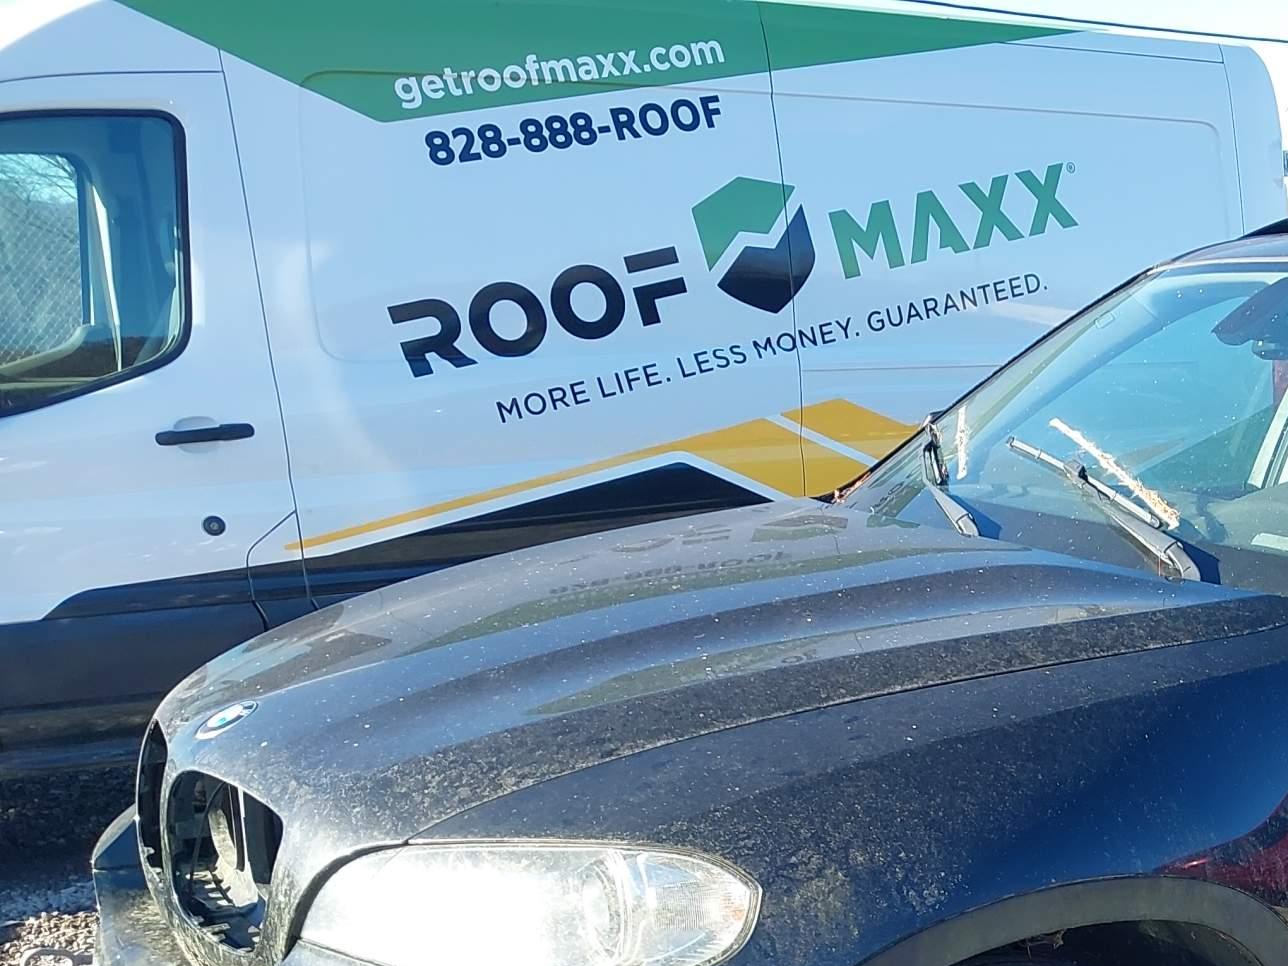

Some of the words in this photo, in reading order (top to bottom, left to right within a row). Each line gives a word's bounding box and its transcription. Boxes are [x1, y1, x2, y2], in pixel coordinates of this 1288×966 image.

[393, 39, 726, 109] getroofmaxx.com
[424, 94, 722, 166] 828-888-ROOF
[386, 246, 689, 378] ROOF
[495, 380, 591, 424] MORE
[596, 362, 672, 399] LIFE.
[676, 344, 748, 379] LESS
[751, 316, 861, 360] MONEY.
[867, 273, 1049, 333] GUARANTEED.
